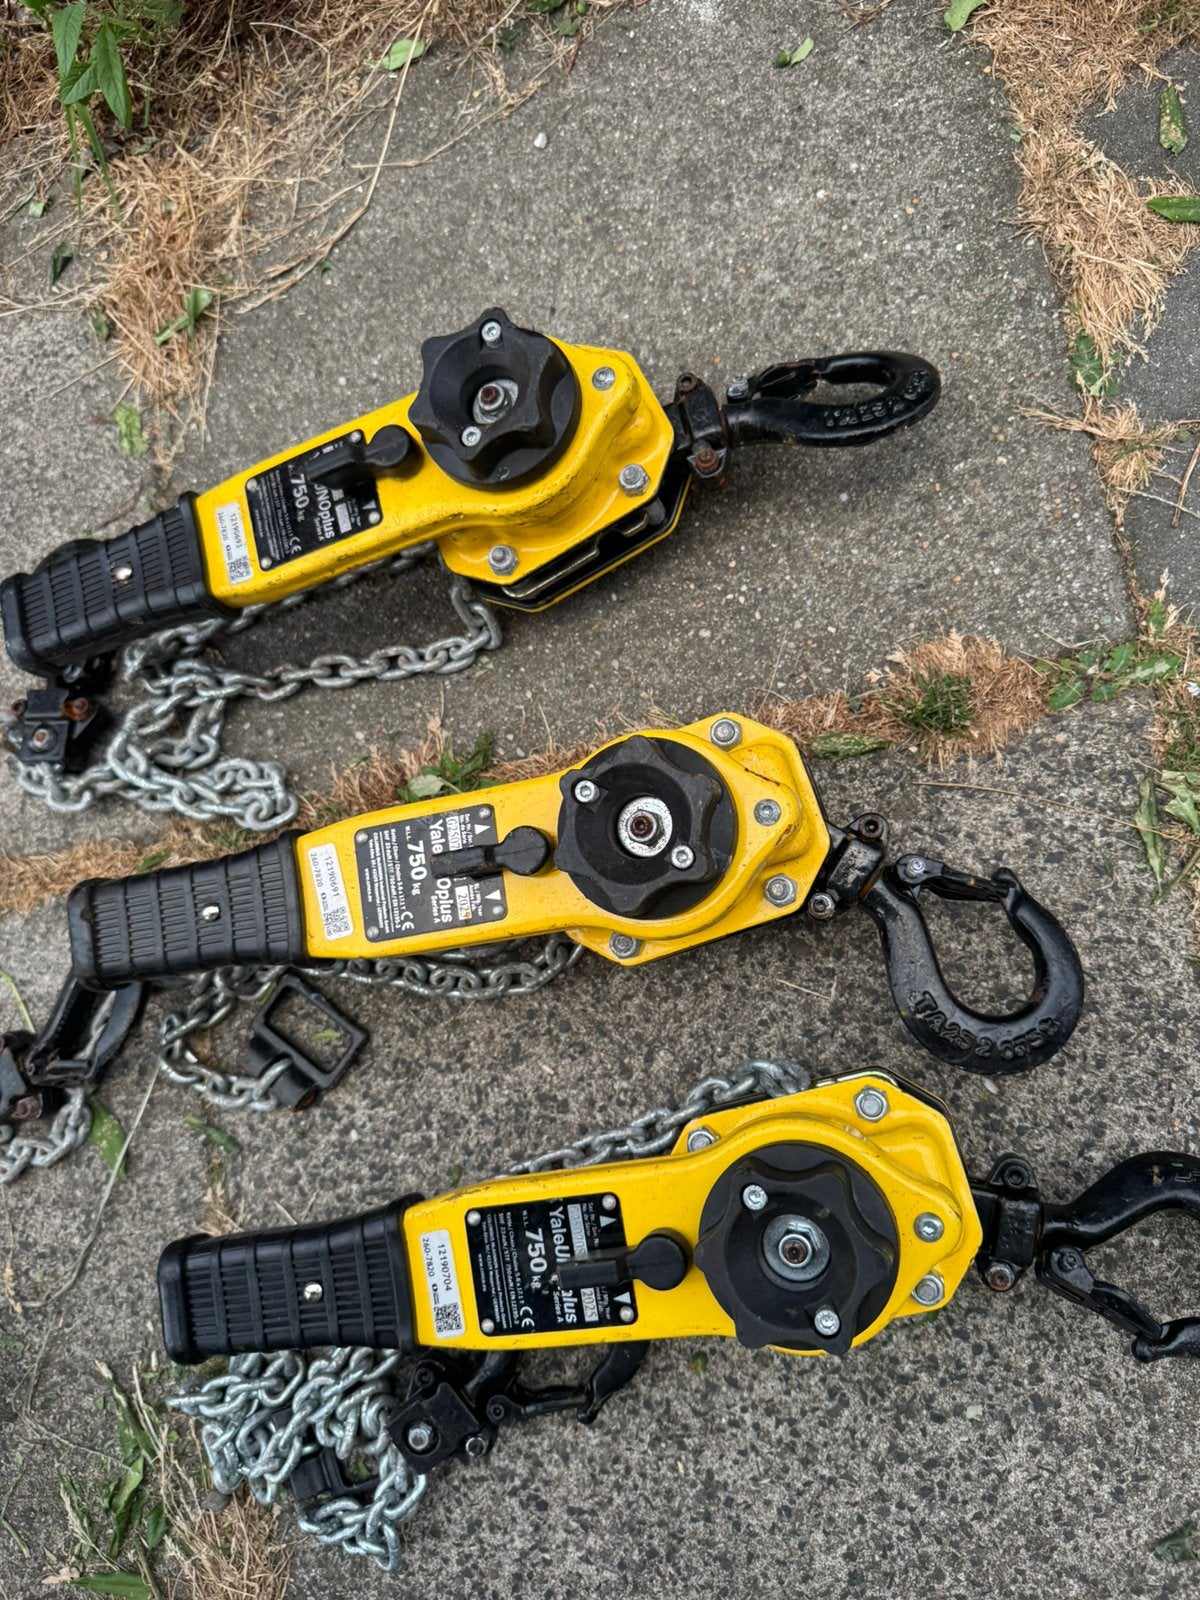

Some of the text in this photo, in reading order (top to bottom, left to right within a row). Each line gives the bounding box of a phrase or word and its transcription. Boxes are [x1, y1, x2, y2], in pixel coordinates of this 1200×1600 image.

[290, 473, 310, 510] 750
[296, 509, 306, 522] kg
[314, 516, 323, 536] Series
[230, 512, 243, 549] 12190693
[289, 535, 302, 554] CE
[310, 852, 324, 888] 260-7820
[407, 840, 428, 881] 750
[324, 856, 340, 897] 12190691
[411, 882, 422, 895] kg
[431, 895, 440, 916] Series
[400, 910, 415, 931] CE
[422, 1237, 435, 1277] 260-7820
[525, 1228, 548, 1273] 750
[437, 1244, 452, 1291] 12190704
[530, 1275, 542, 1289] kg
[553, 1291, 563, 1315] Series
[582, 1290, 596, 1319] 2025
[519, 1306, 535, 1328] CE
